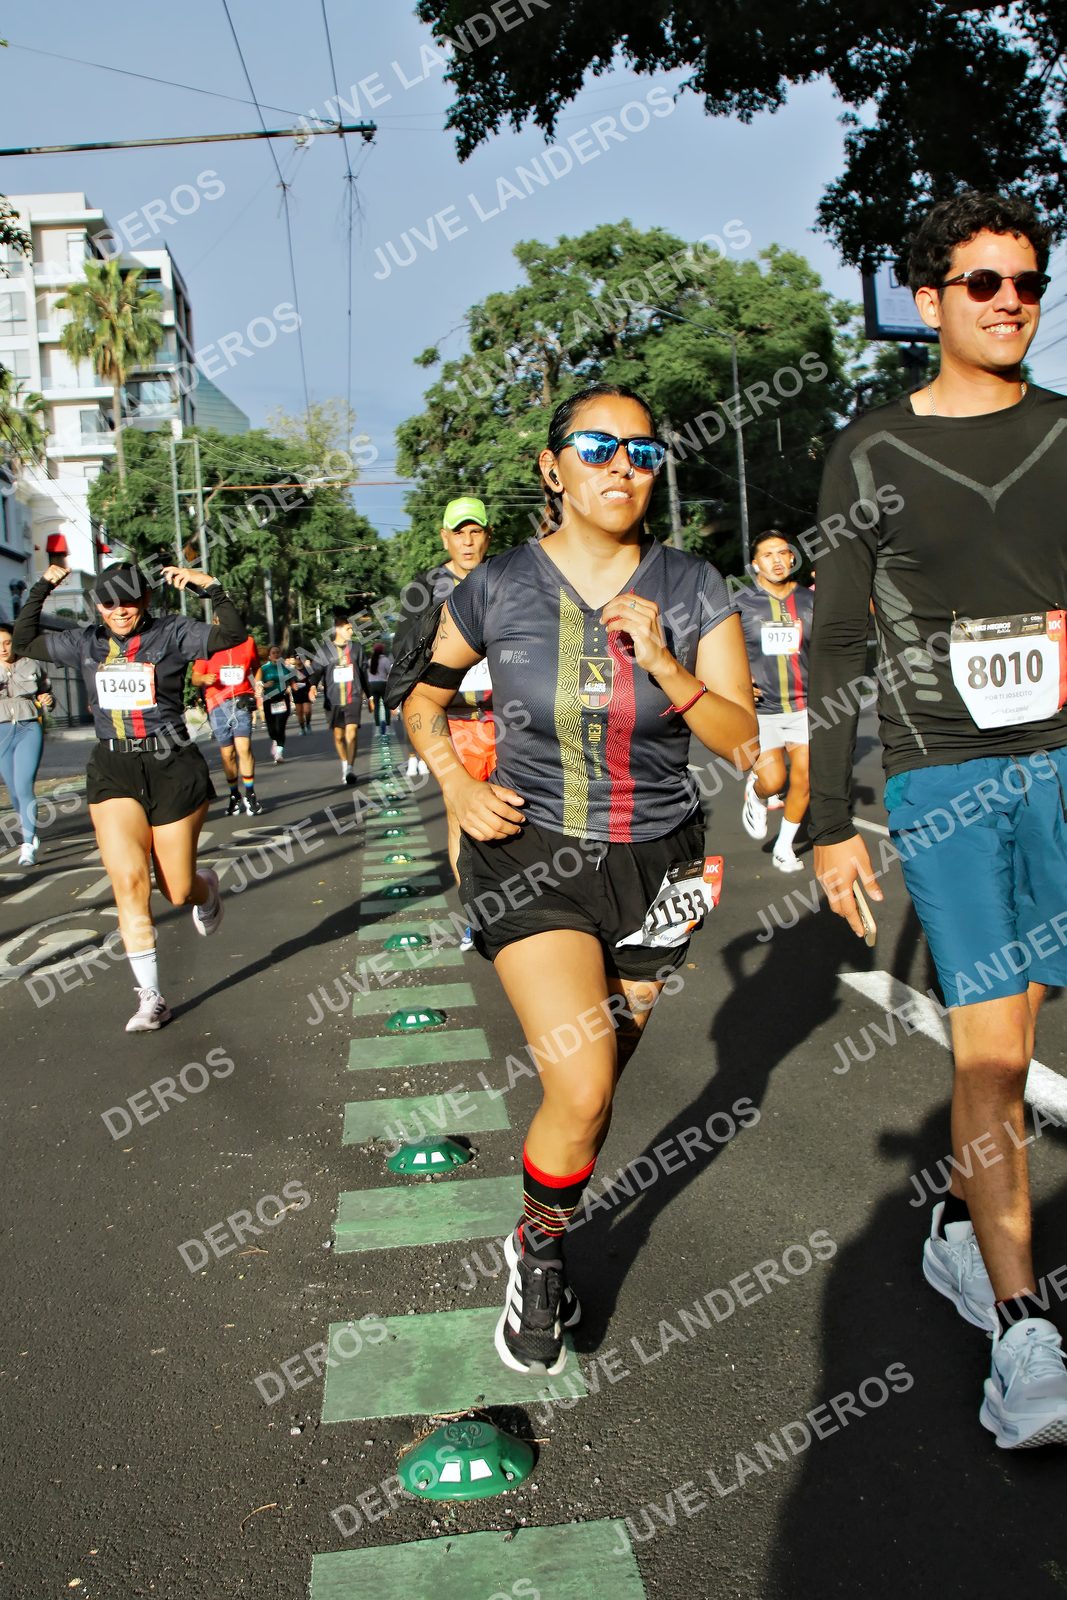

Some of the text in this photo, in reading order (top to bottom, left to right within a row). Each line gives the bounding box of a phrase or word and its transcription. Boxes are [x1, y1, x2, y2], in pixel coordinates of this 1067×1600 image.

[768, 632, 793, 643] 9175
[967, 649, 1044, 690] 8010
[100, 678, 146, 693] 13405
